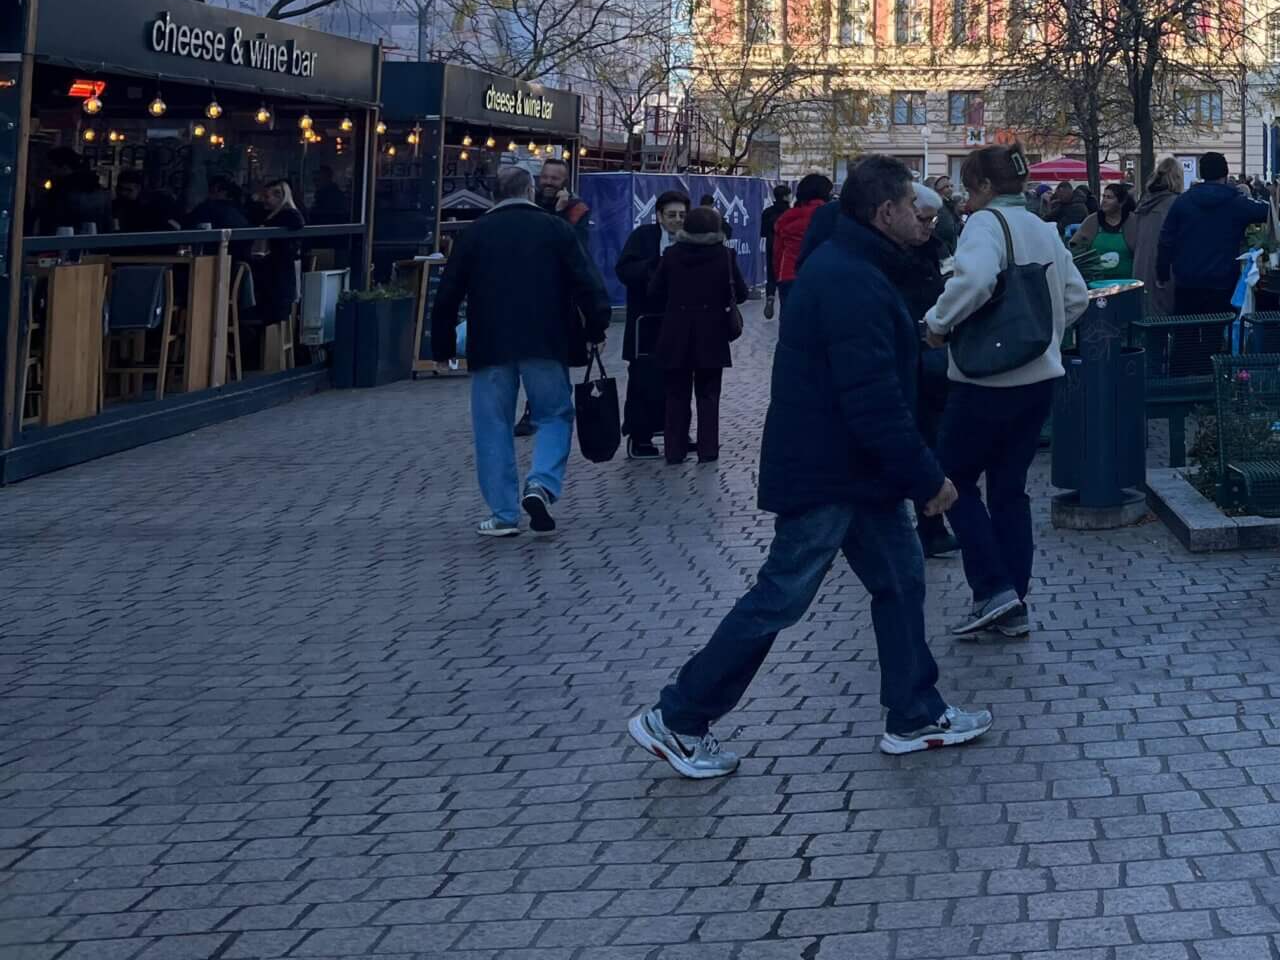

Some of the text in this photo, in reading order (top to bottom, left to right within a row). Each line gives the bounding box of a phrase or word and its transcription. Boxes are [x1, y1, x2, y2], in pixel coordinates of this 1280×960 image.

[152, 11, 318, 77] cheese & wine bar
[486, 83, 554, 119] cheese & wine bar
